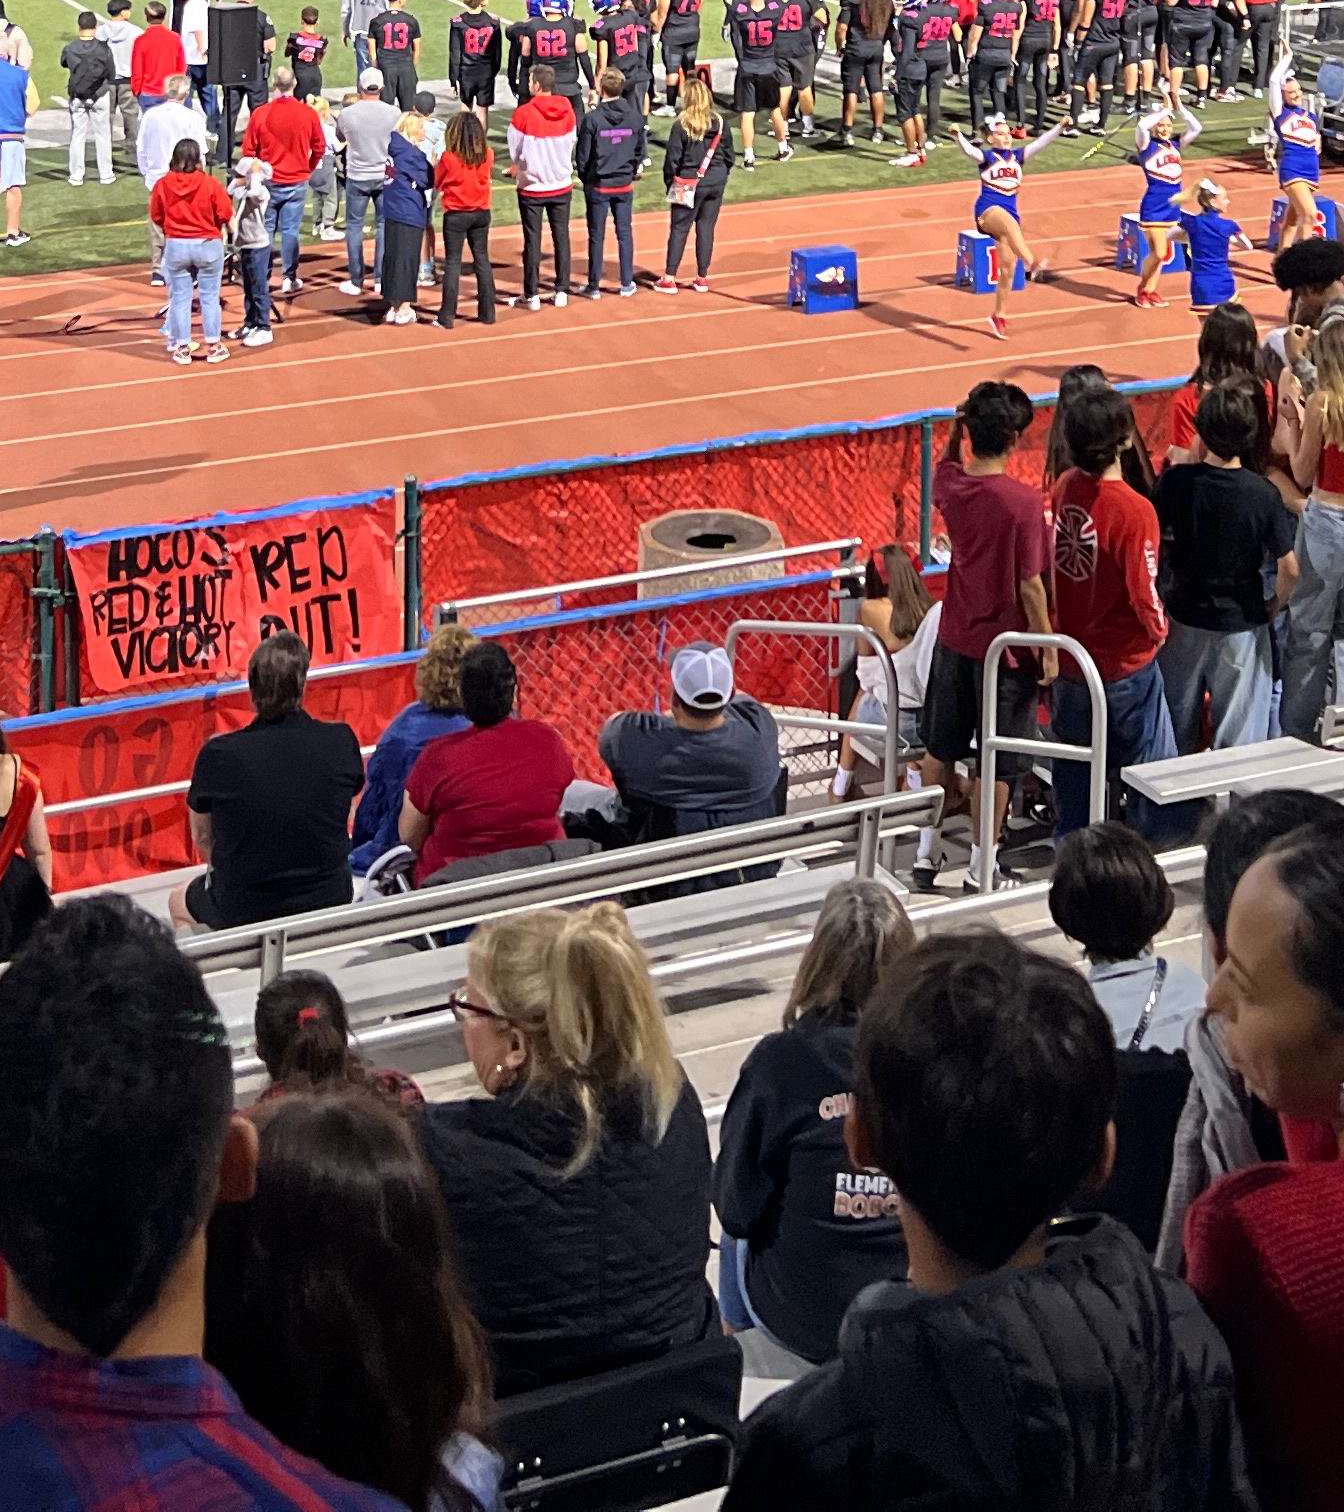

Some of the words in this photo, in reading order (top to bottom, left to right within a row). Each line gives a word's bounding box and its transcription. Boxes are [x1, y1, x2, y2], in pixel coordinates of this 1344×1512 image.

[383, 22, 409, 49] 13
[464, 26, 494, 55] 87
[536, 29, 567, 57] 62
[747, 20, 773, 47] 15
[297, 47, 315, 62] 4
[107, 525, 232, 582] HOCO'S
[250, 525, 349, 603] RED
[90, 582, 150, 637] RED
[178, 569, 233, 625] HOT
[111, 620, 236, 680] VICTORY
